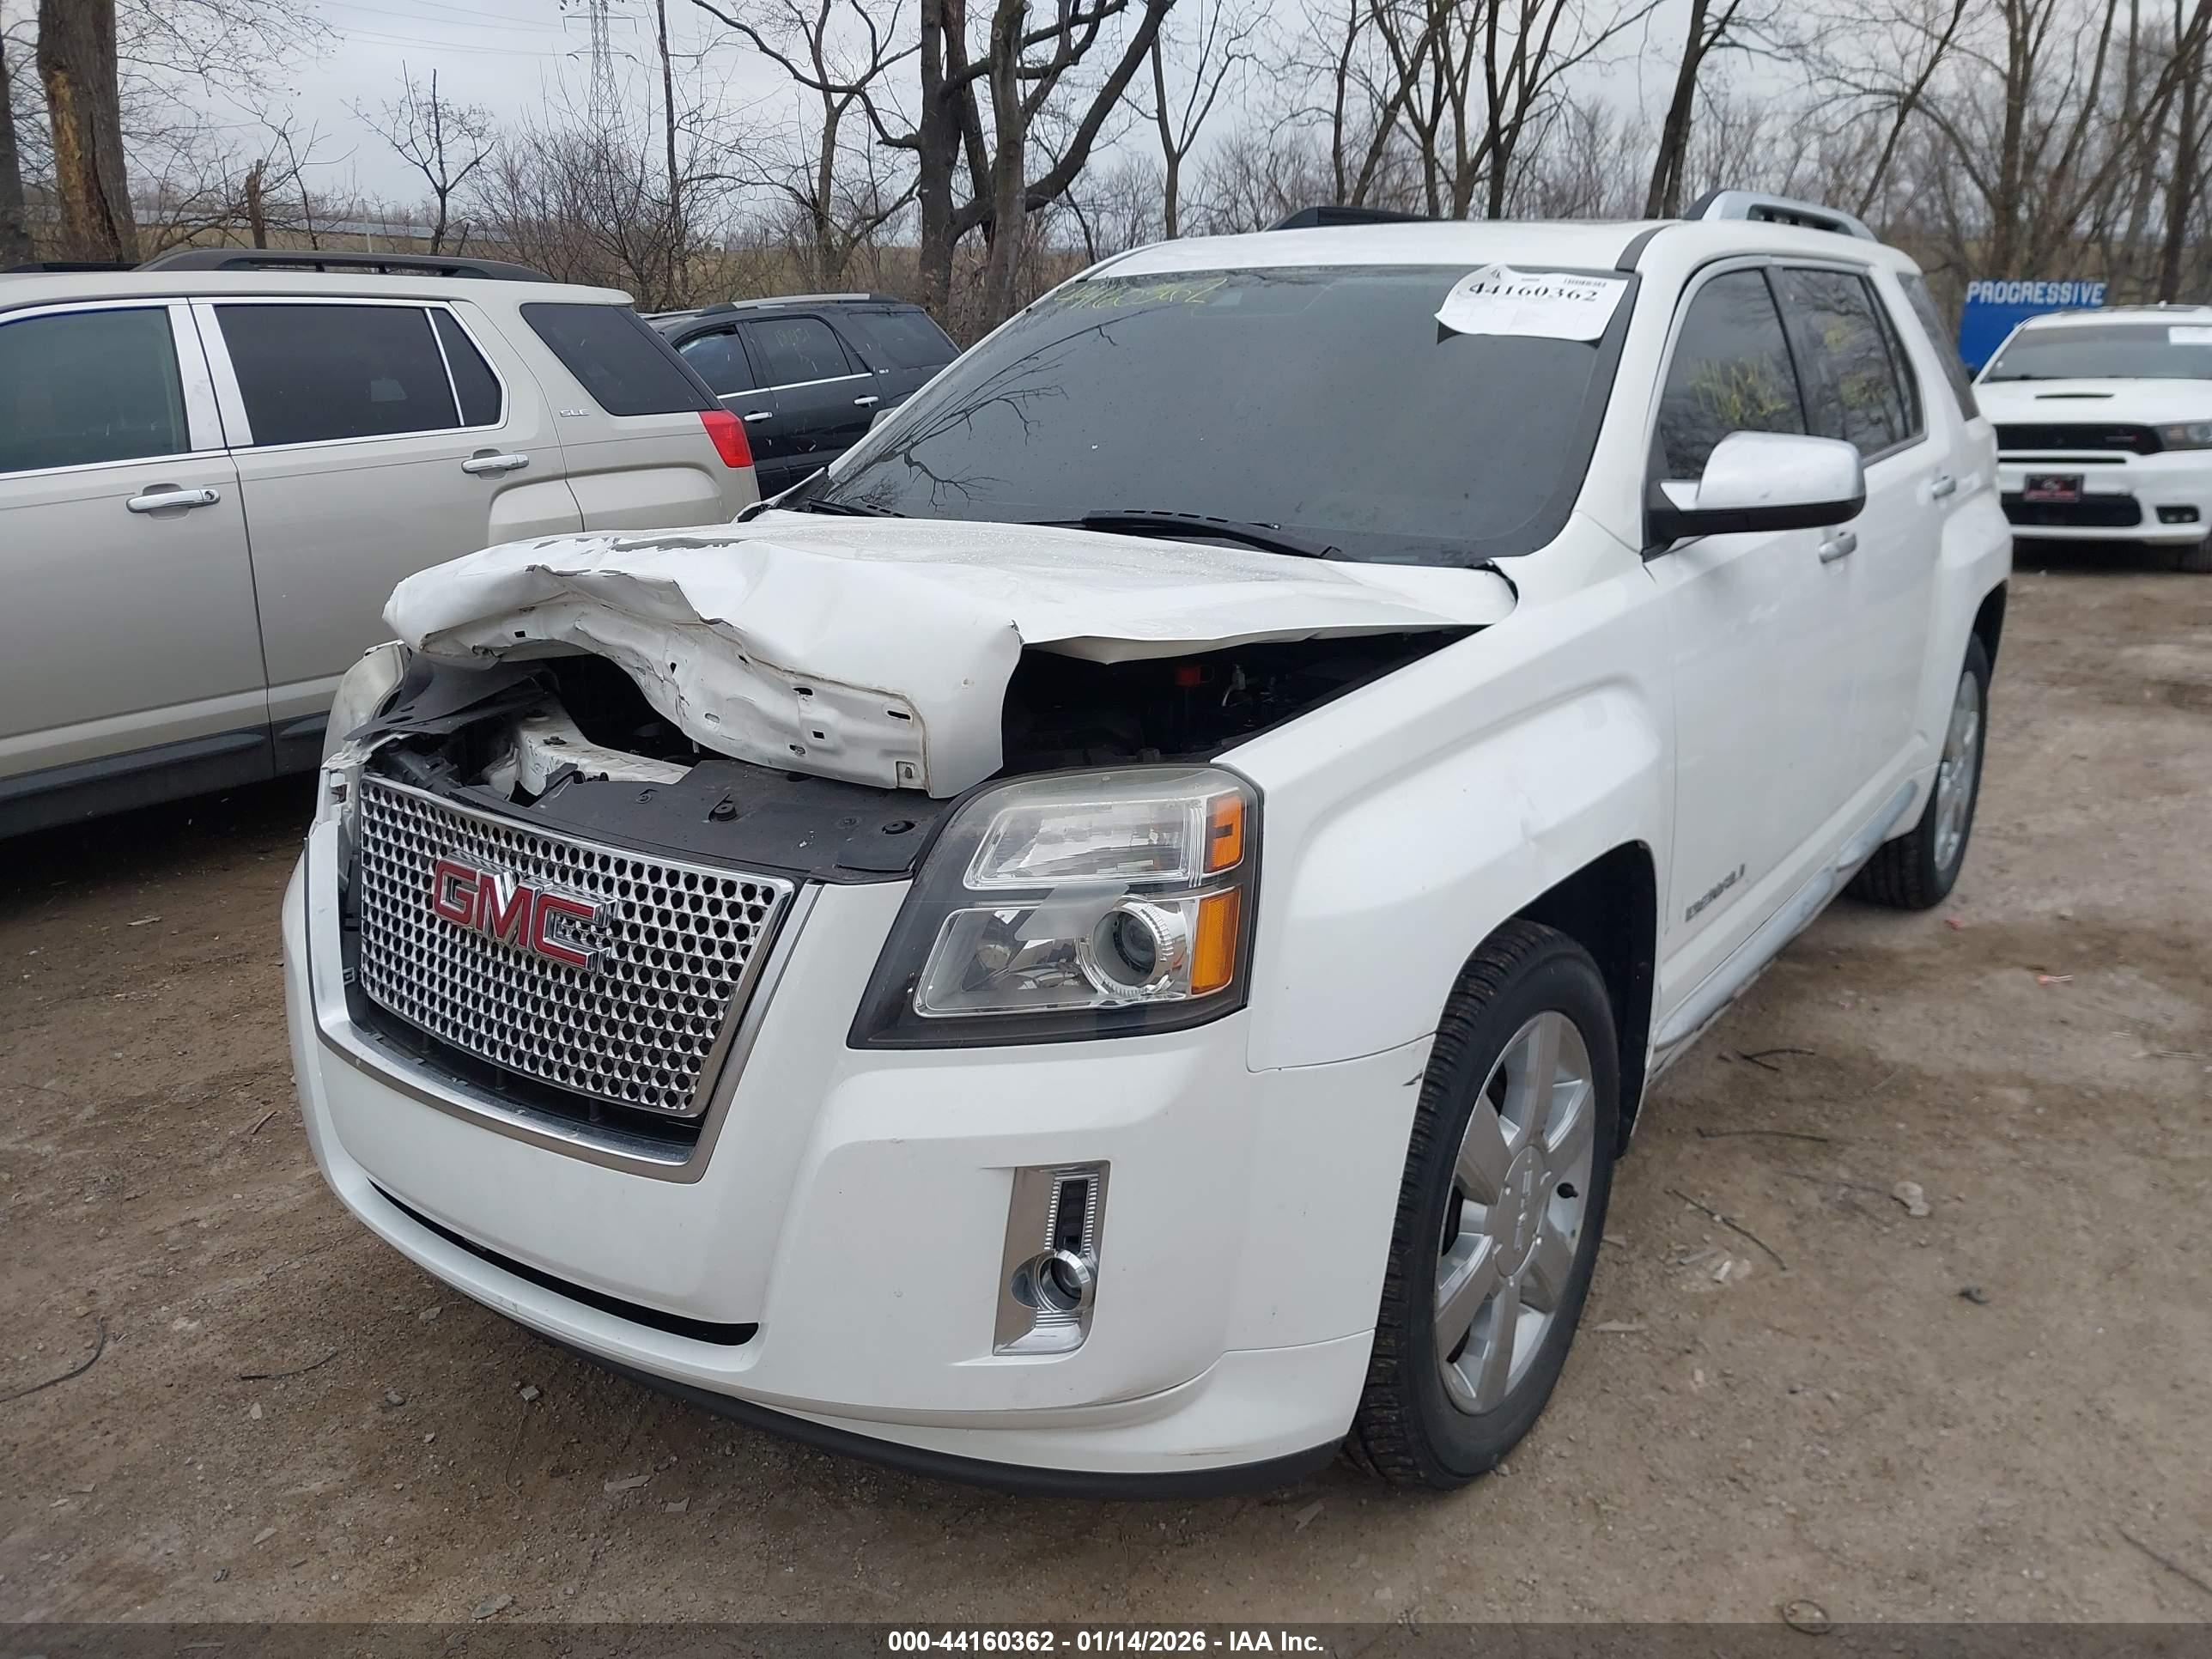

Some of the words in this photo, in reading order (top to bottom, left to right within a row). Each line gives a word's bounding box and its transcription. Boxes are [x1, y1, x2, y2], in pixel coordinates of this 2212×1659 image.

[1468, 282, 1599, 301] 44160362
[1966, 281, 2107, 305] PROGRESSIVE
[433, 857, 603, 970] GMC
